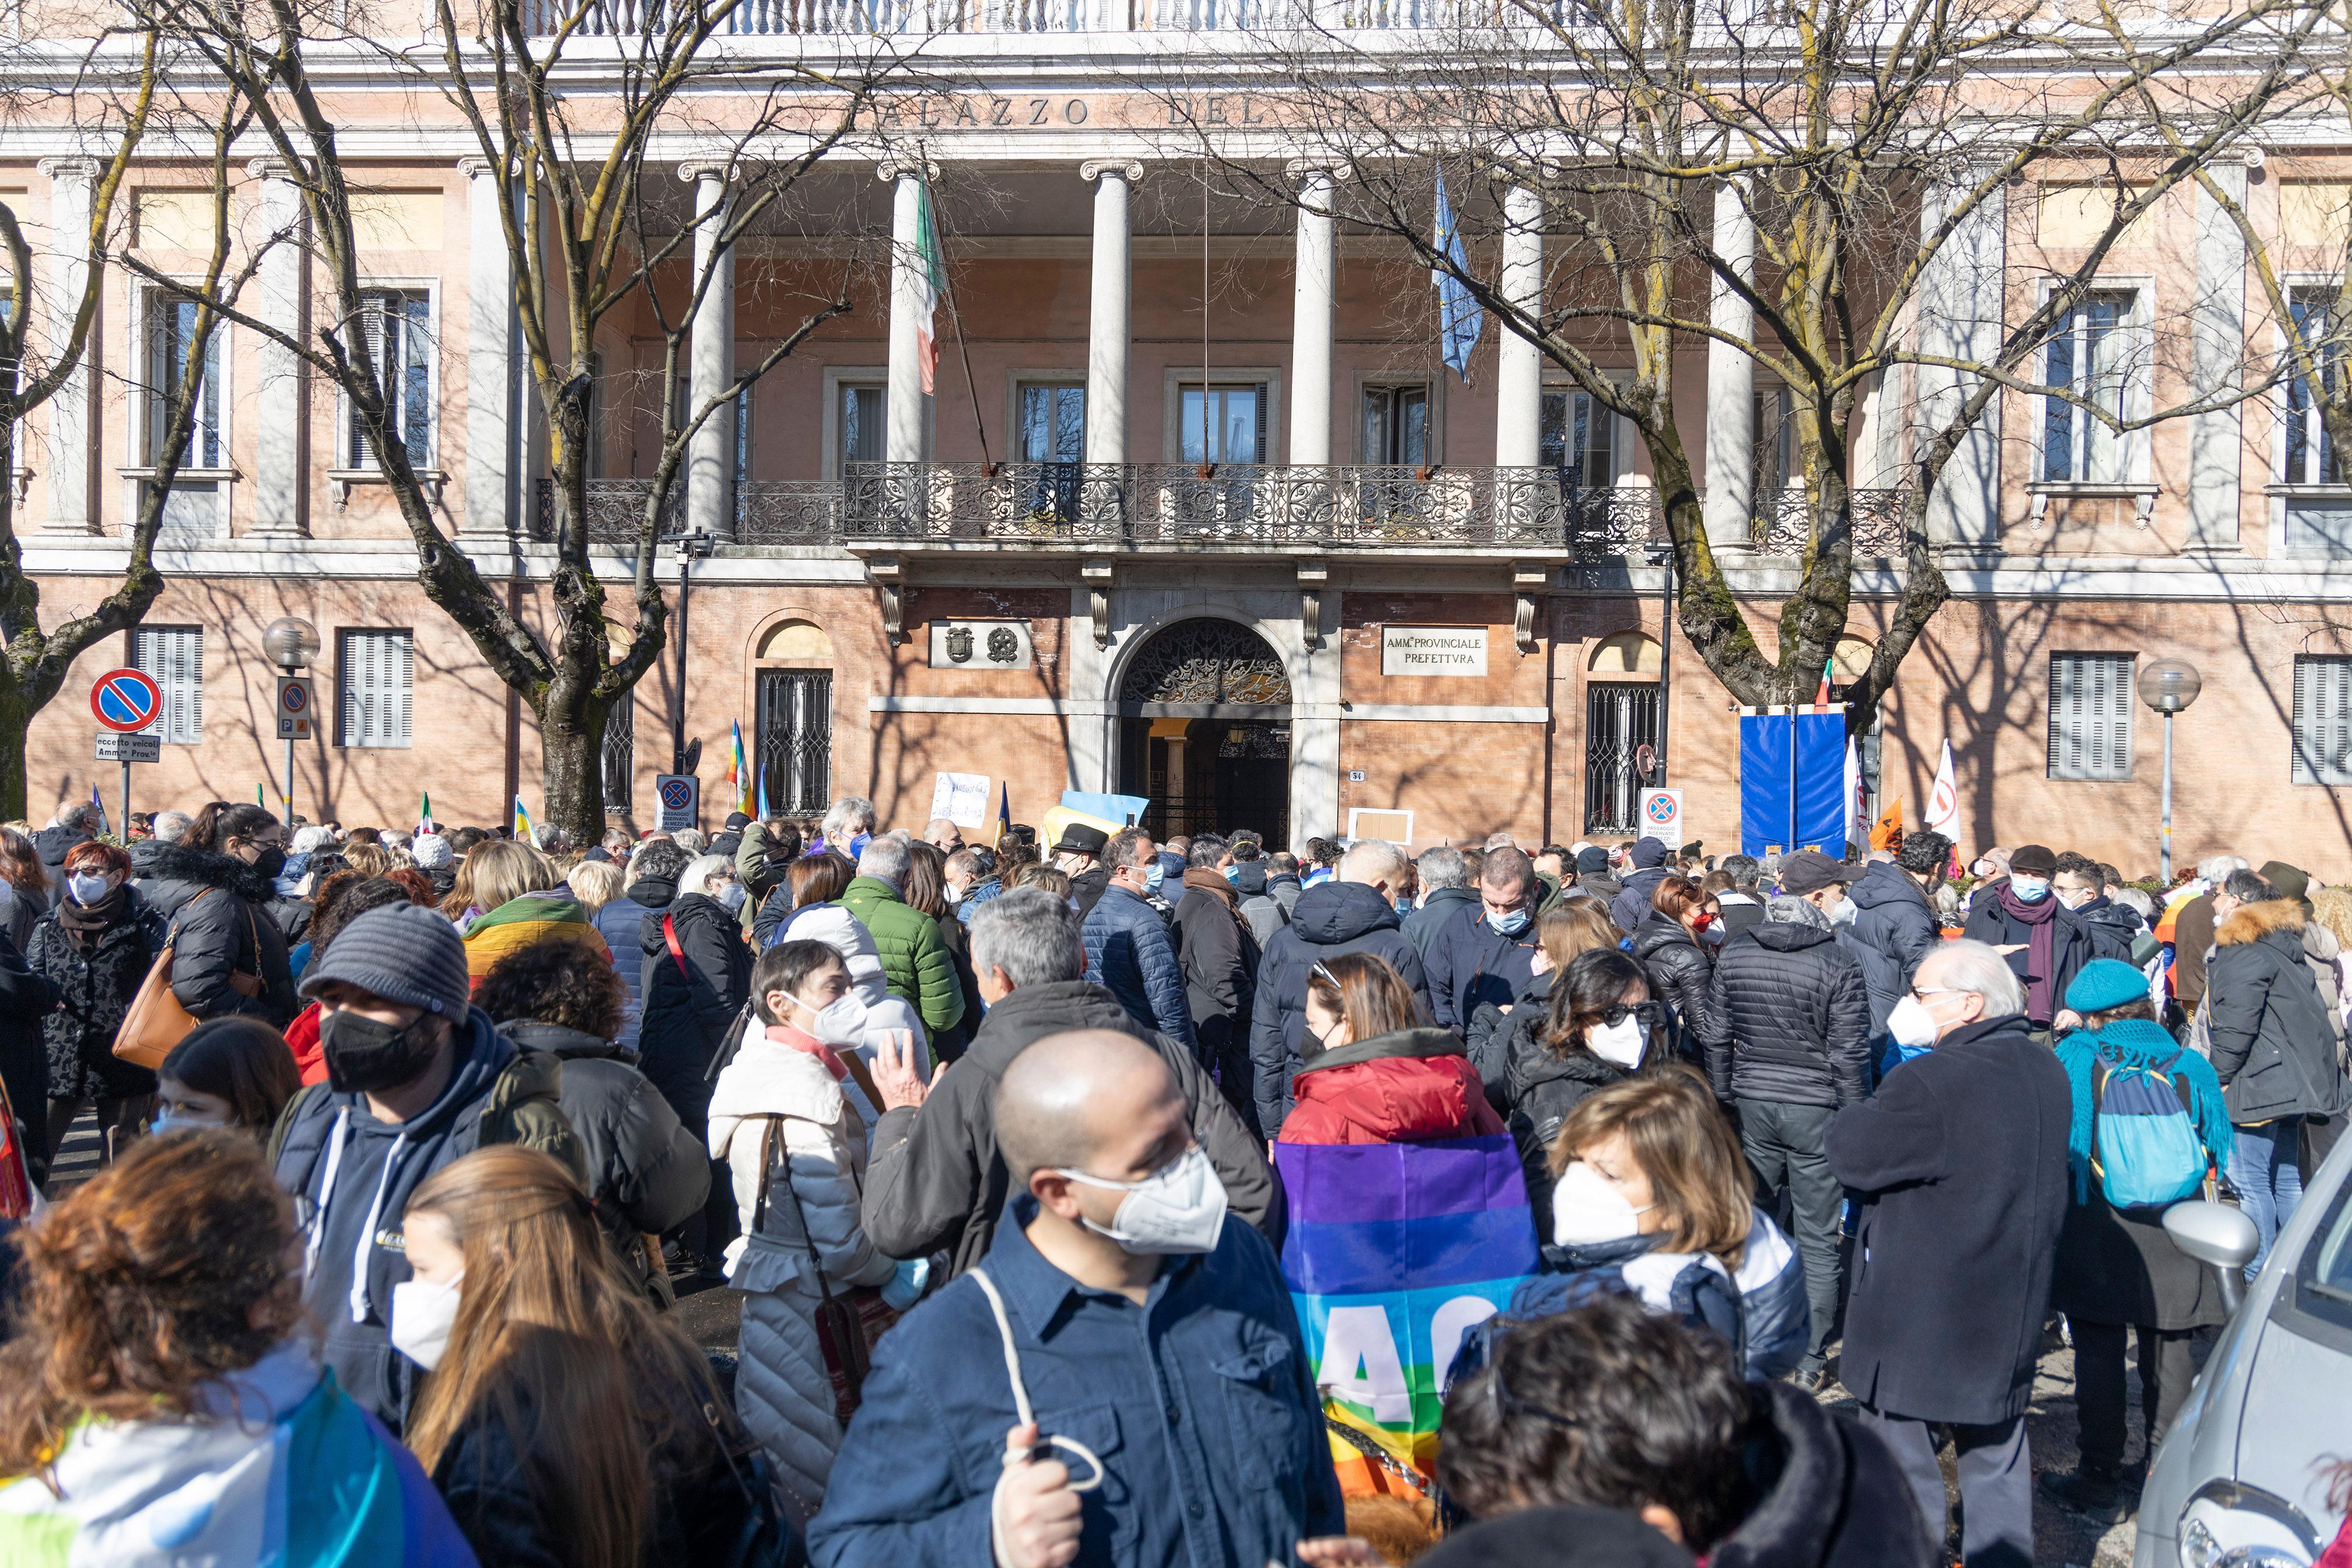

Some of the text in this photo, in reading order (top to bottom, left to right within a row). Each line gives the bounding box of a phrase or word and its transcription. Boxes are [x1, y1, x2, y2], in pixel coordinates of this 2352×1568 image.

[1168, 96, 1264, 124] DEL
[1415, 639, 1481, 649] PROVINCIALE
[1405, 653, 1475, 664] PREFETTVRA
[97, 738, 159, 748] eccetto veicoli
